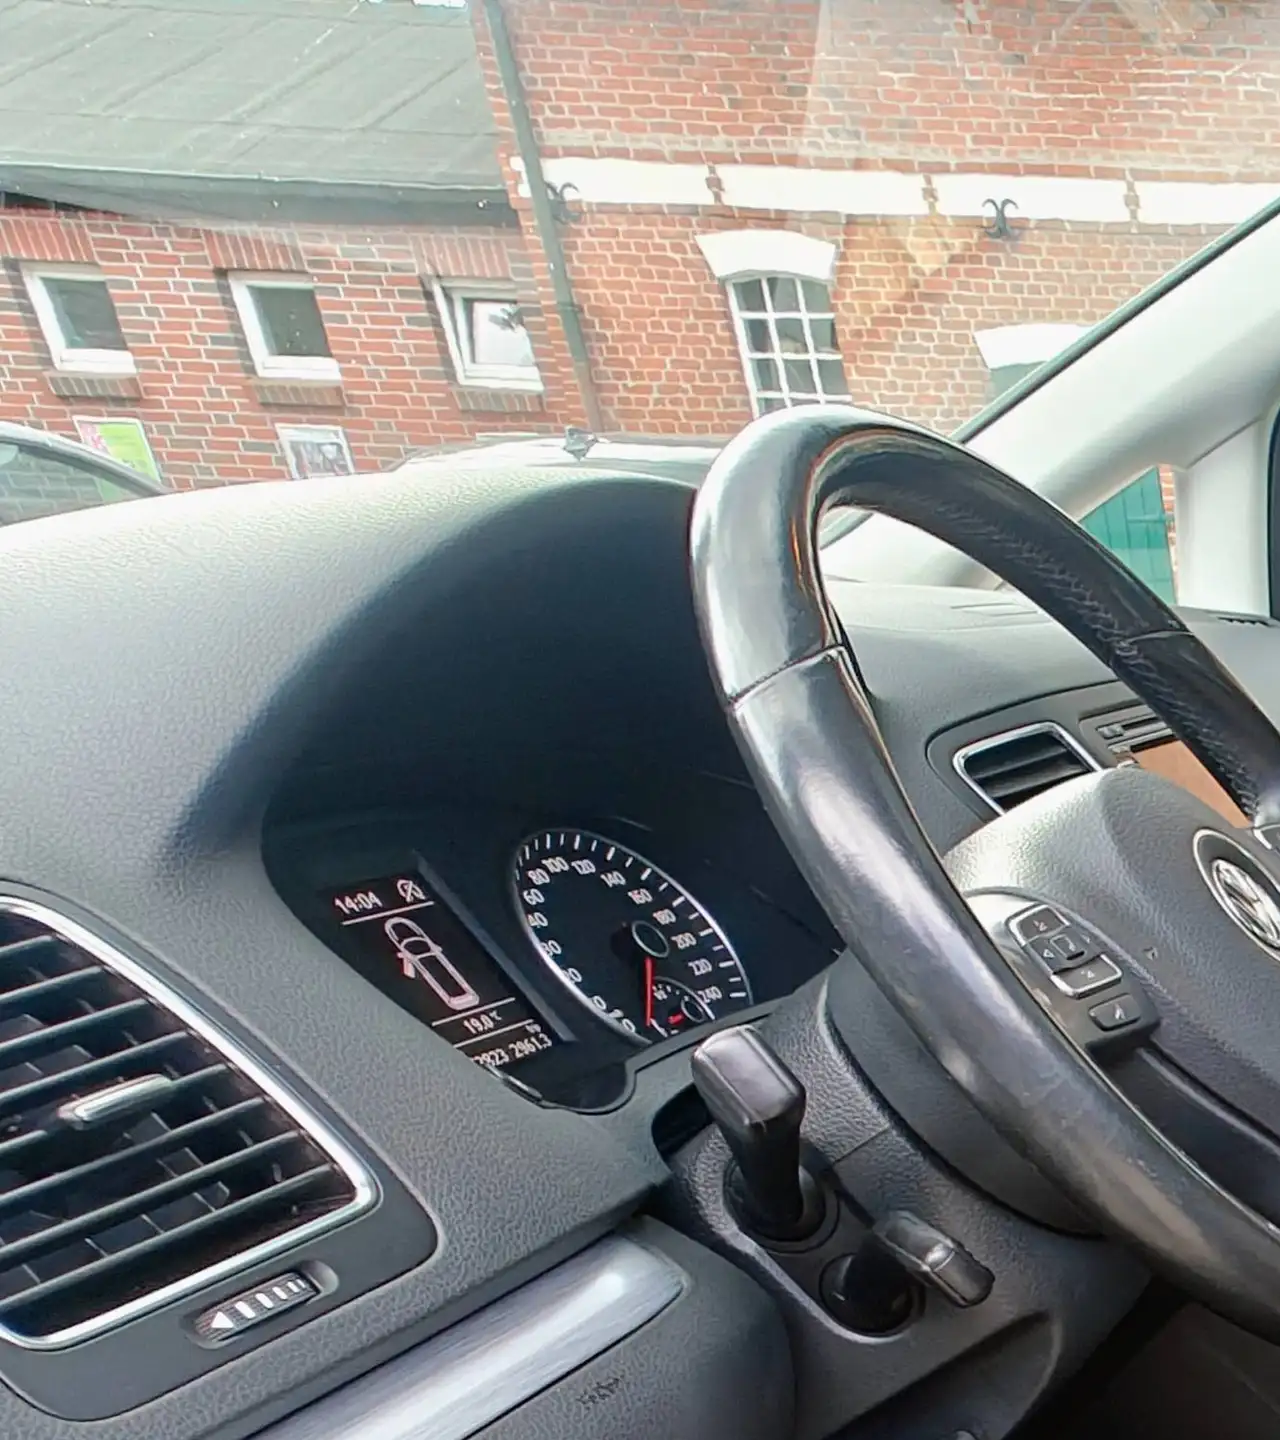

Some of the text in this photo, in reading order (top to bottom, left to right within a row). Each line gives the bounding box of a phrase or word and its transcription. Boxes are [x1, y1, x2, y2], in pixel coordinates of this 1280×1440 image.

[540, 857, 569, 873] 100
[571, 859, 596, 875] 120
[528, 868, 550, 885] 80
[600, 870, 626, 887] 140
[334, 891, 383, 915] 14:04
[522, 888, 545, 905] 60
[688, 958, 713, 976] 220
[697, 986, 723, 1003] 240
